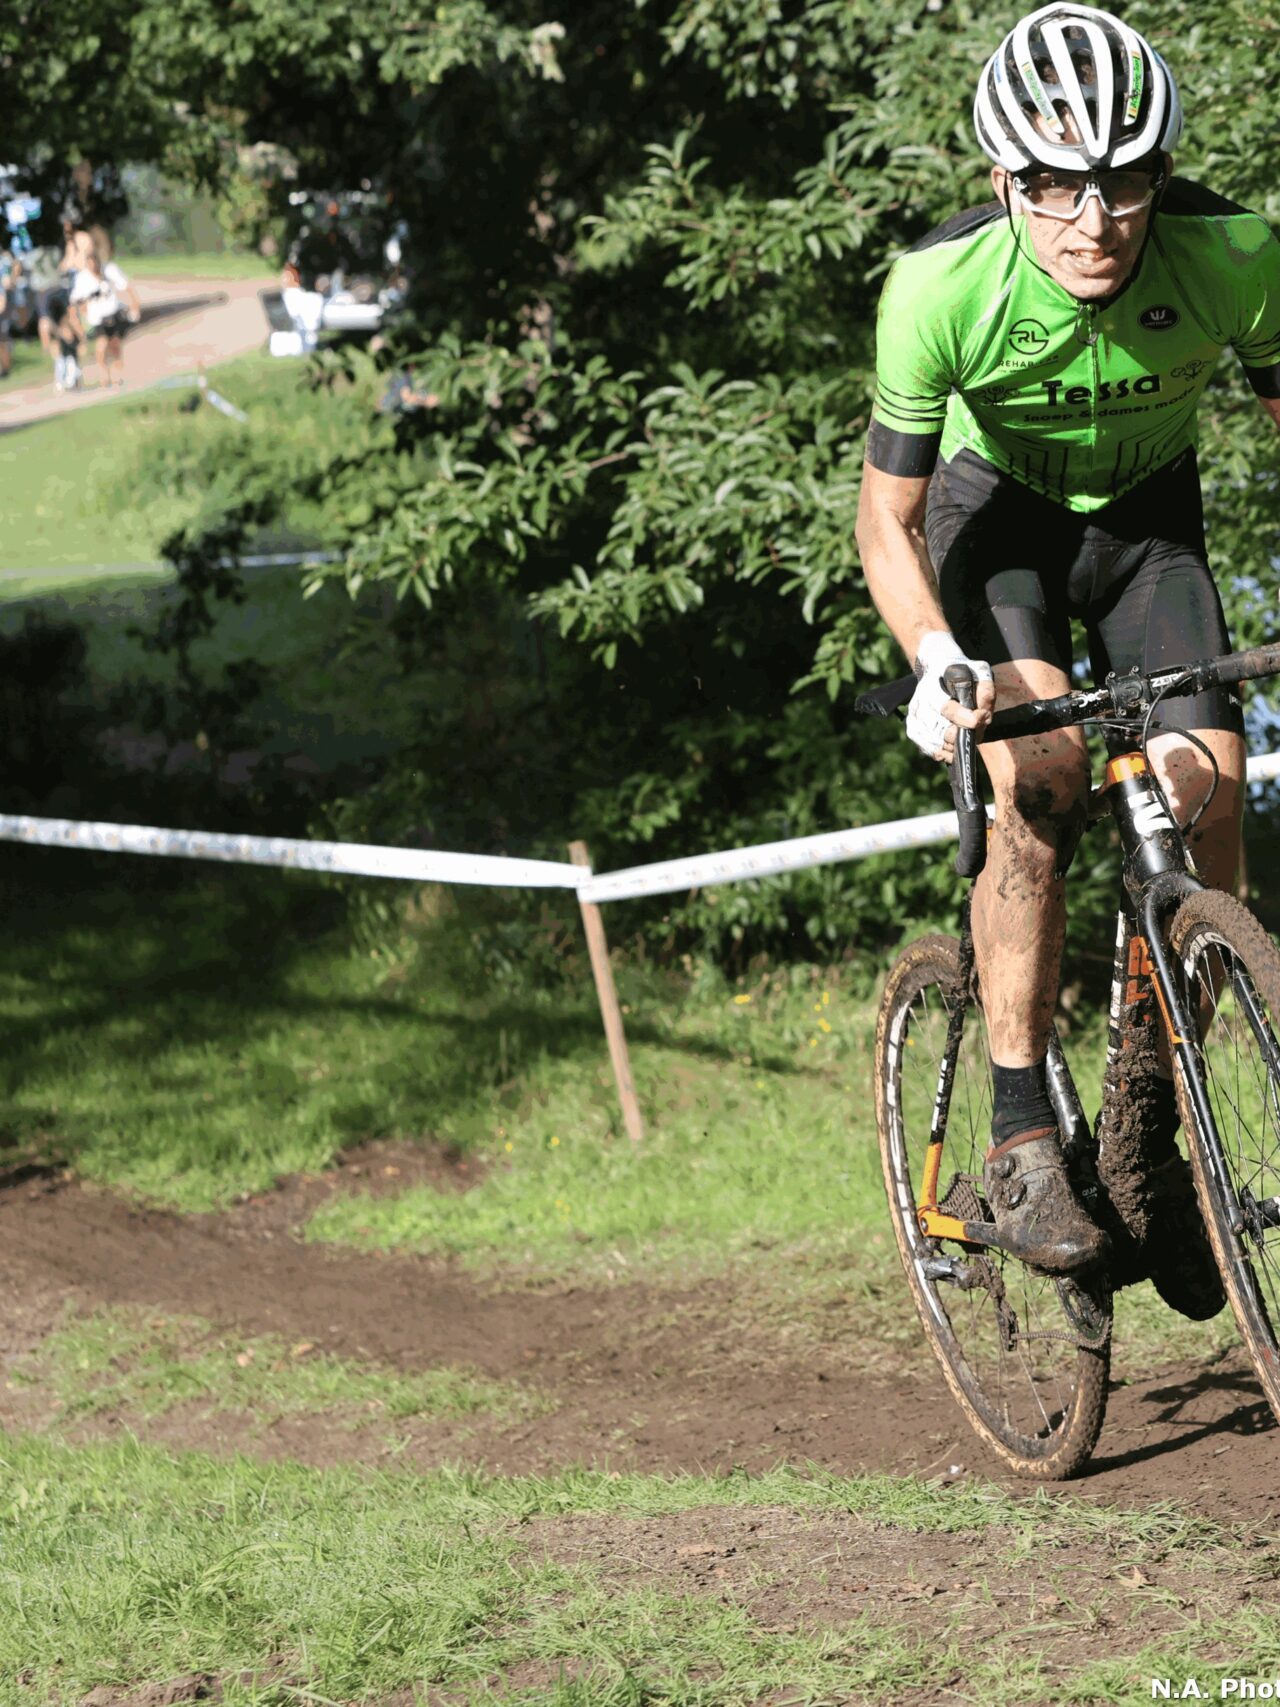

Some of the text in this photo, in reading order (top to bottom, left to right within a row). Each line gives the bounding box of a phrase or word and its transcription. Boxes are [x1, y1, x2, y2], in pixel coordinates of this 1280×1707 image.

[1042, 374, 1161, 406] Tessa
[1024, 413, 1073, 423] Snoep
[1079, 409, 1090, 418] &
[1097, 402, 1150, 417] dames
